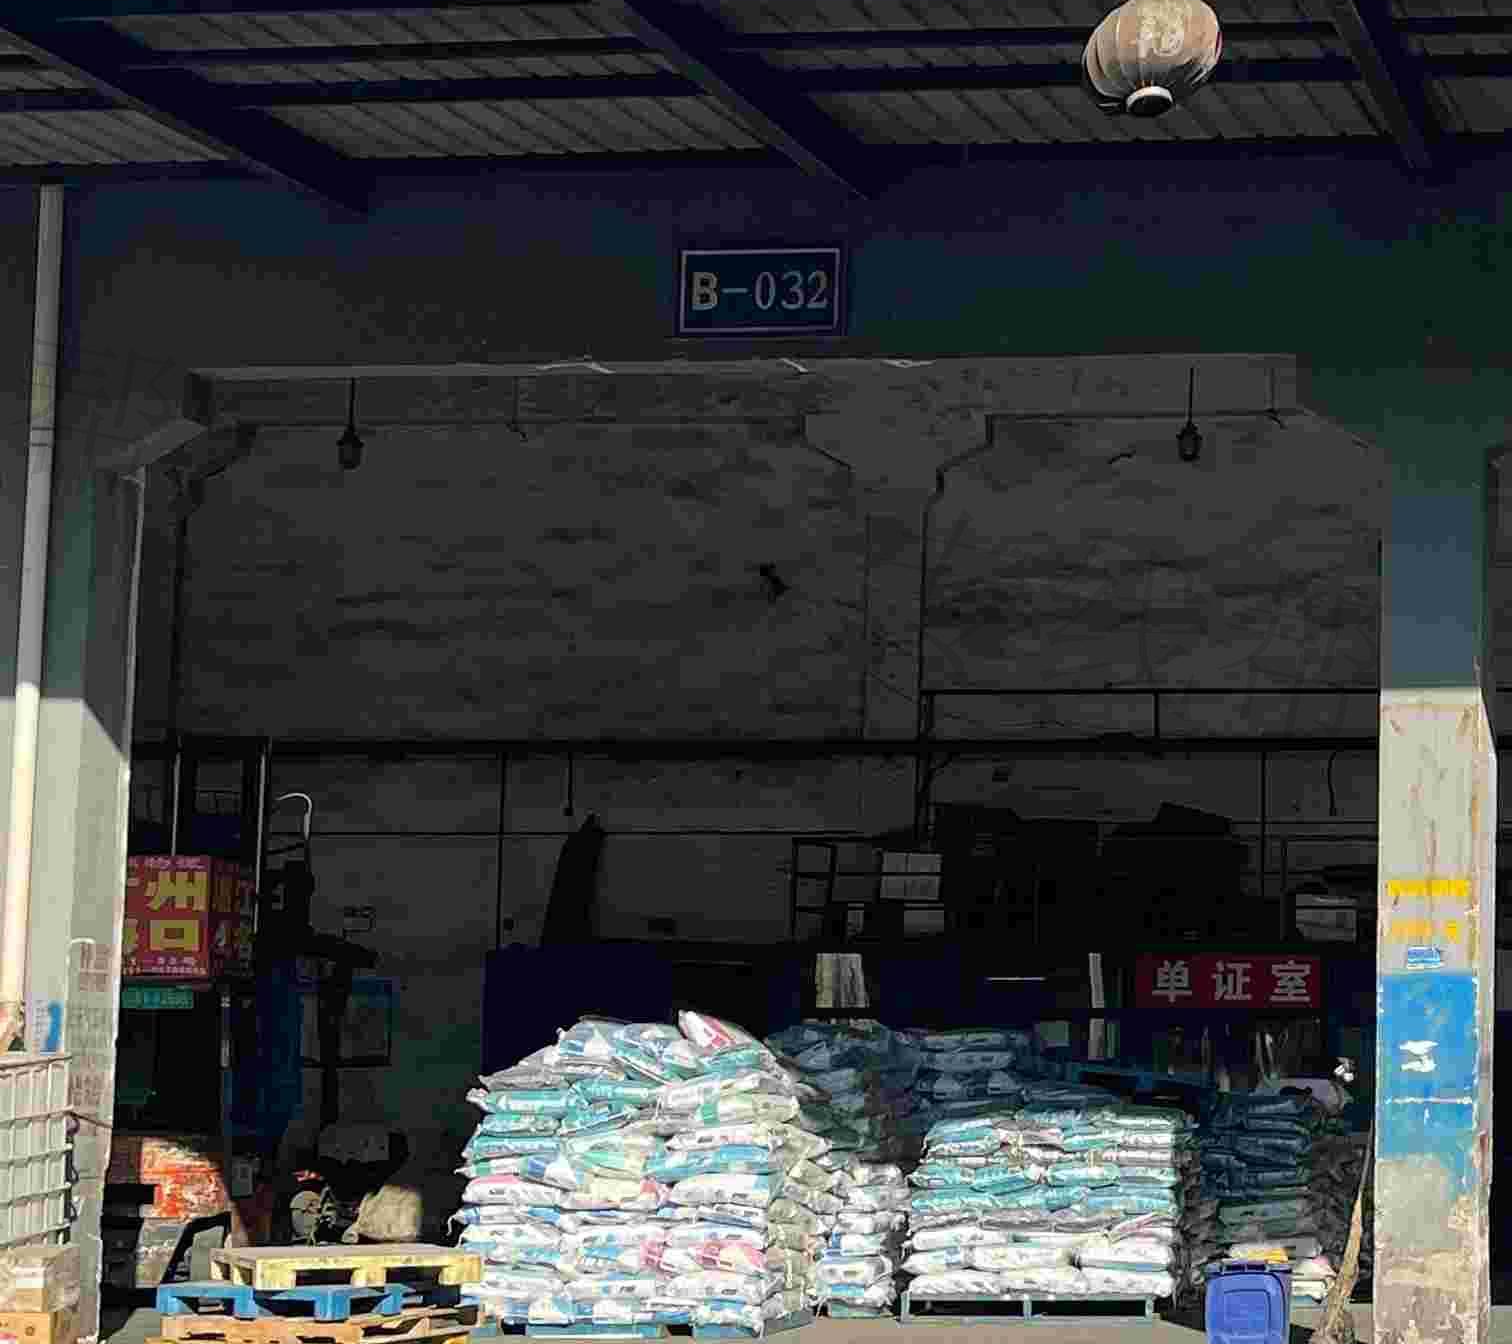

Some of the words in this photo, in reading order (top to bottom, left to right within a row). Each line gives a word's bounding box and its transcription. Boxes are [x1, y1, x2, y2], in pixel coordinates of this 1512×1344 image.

[690, 269, 833, 312] B-032
[1151, 958, 1313, 1006] 单证室
